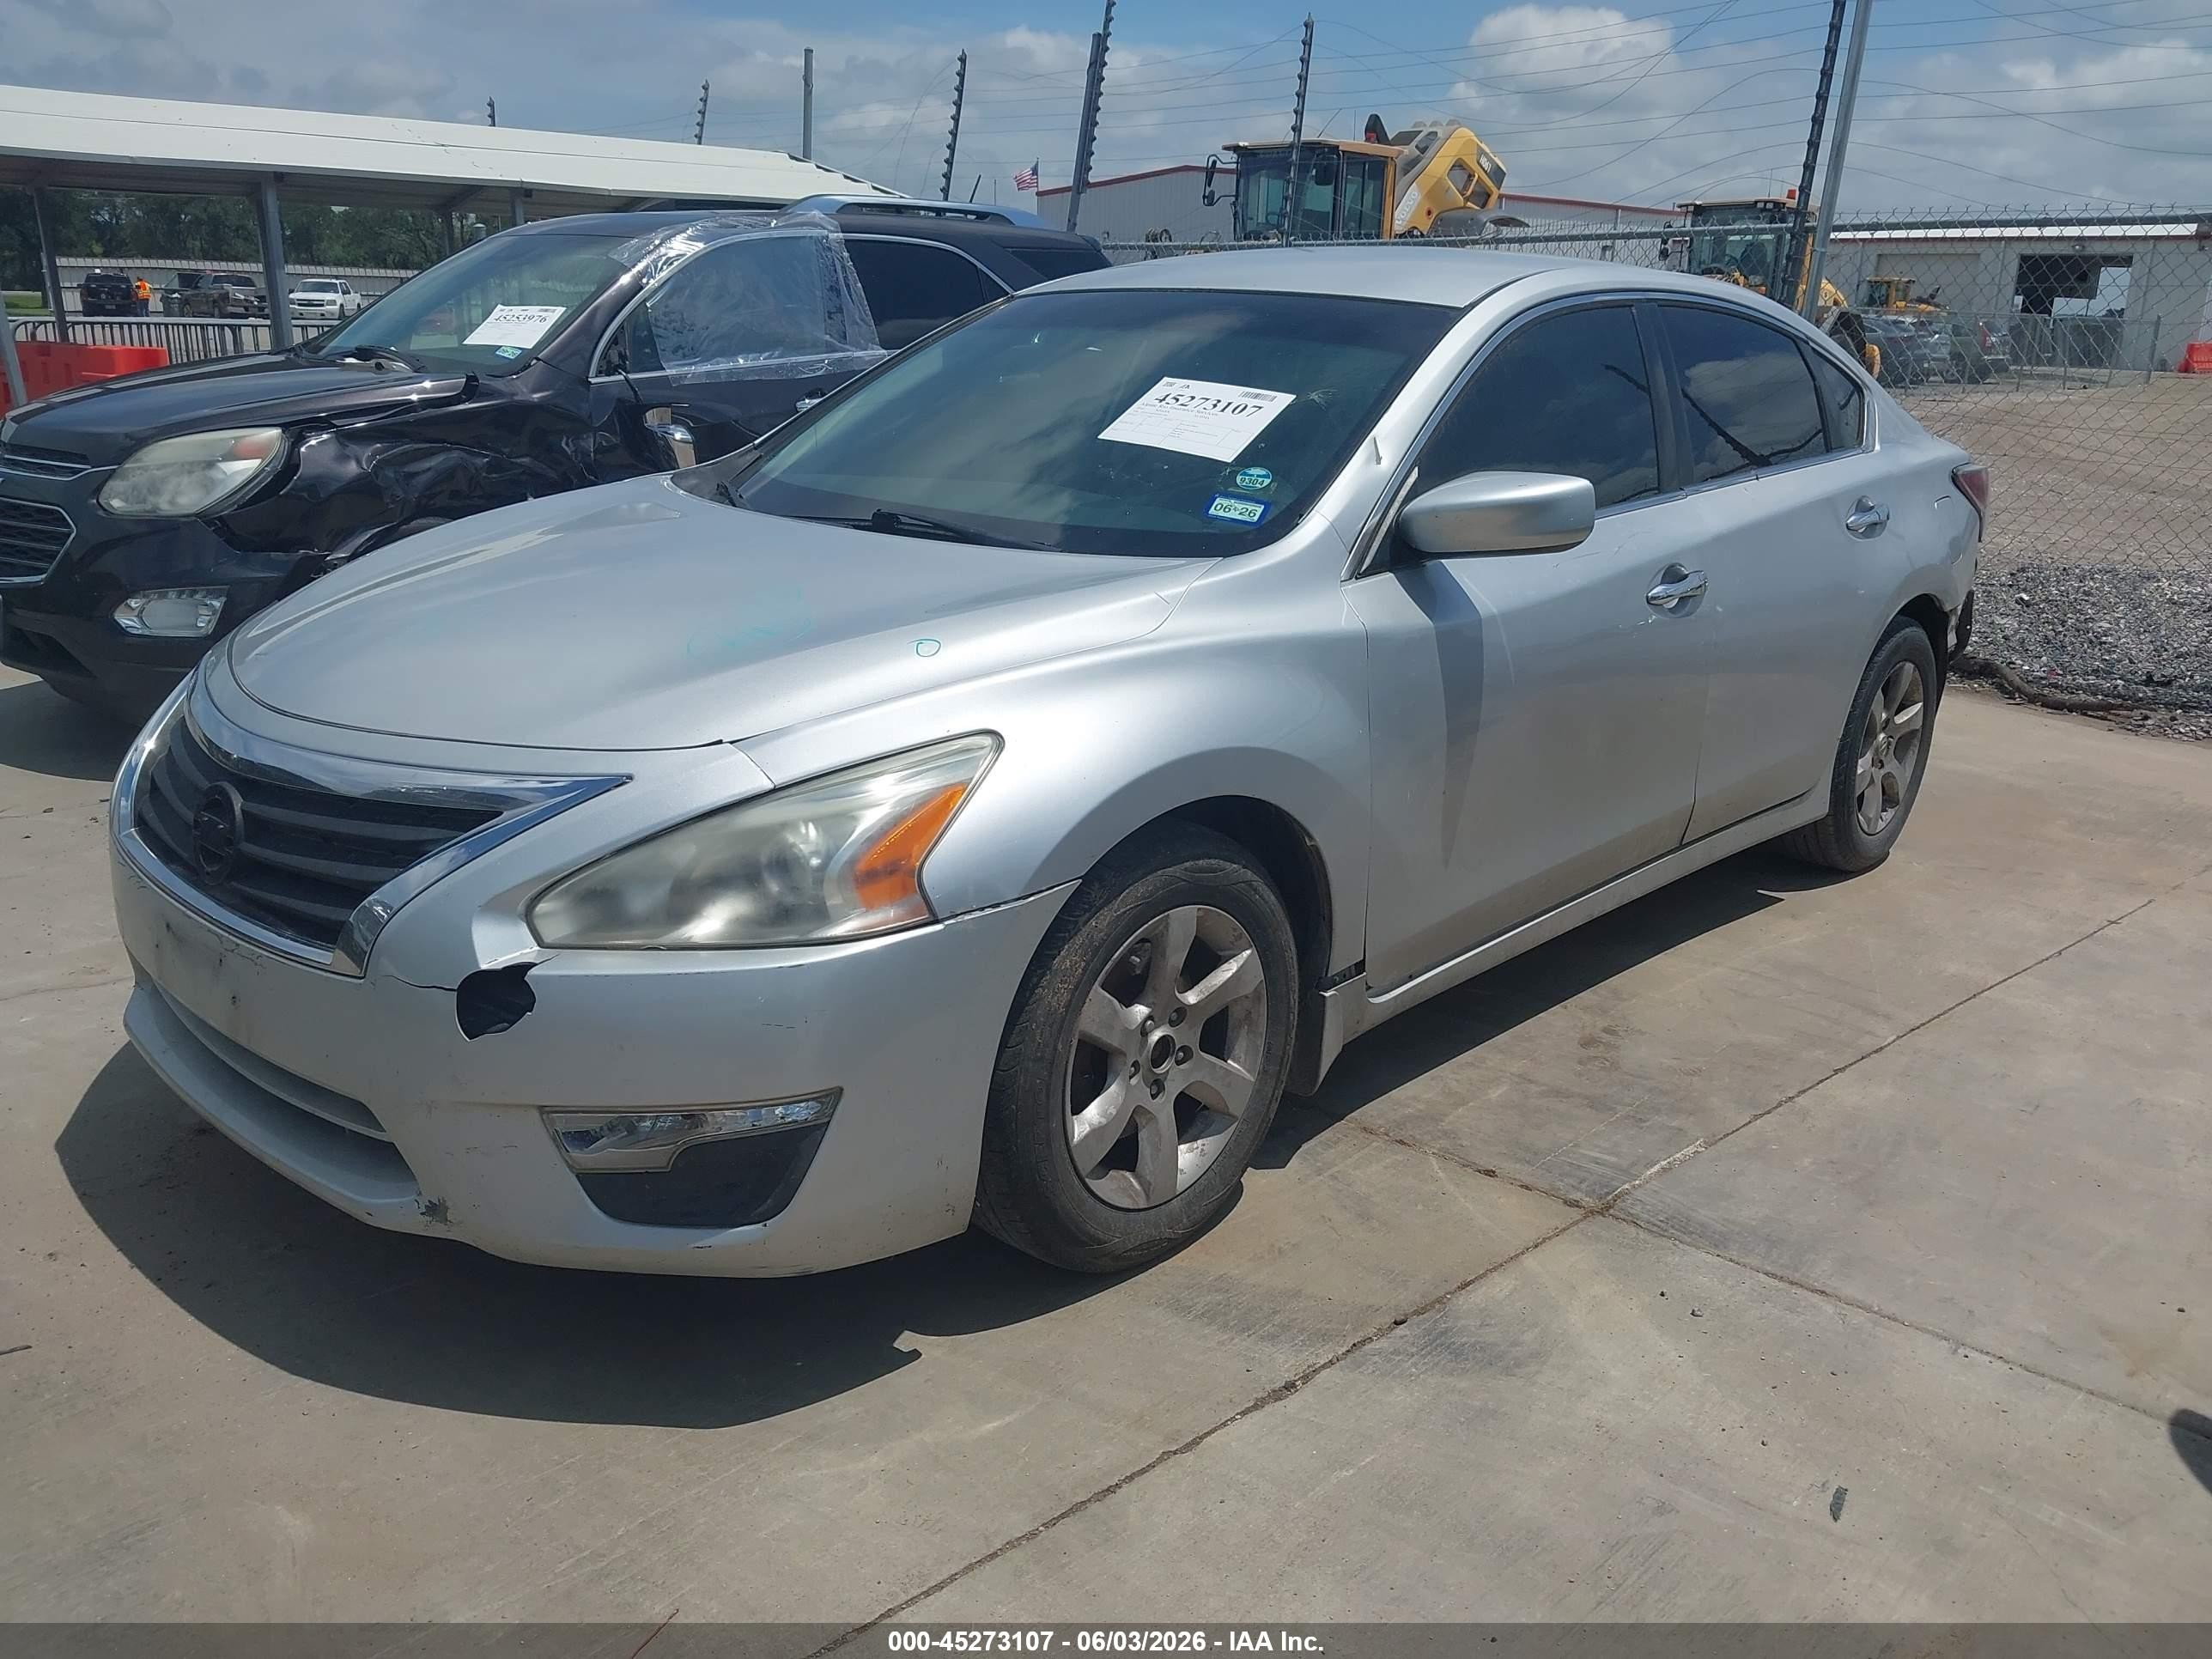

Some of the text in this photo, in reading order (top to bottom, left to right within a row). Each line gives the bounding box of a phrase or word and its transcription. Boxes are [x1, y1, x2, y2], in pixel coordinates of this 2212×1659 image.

[1395, 191, 1419, 225] VOLVO
[494, 314, 549, 323] 45253976
[1154, 392, 1264, 417] 45273107
[1239, 477, 1265, 487] 9304
